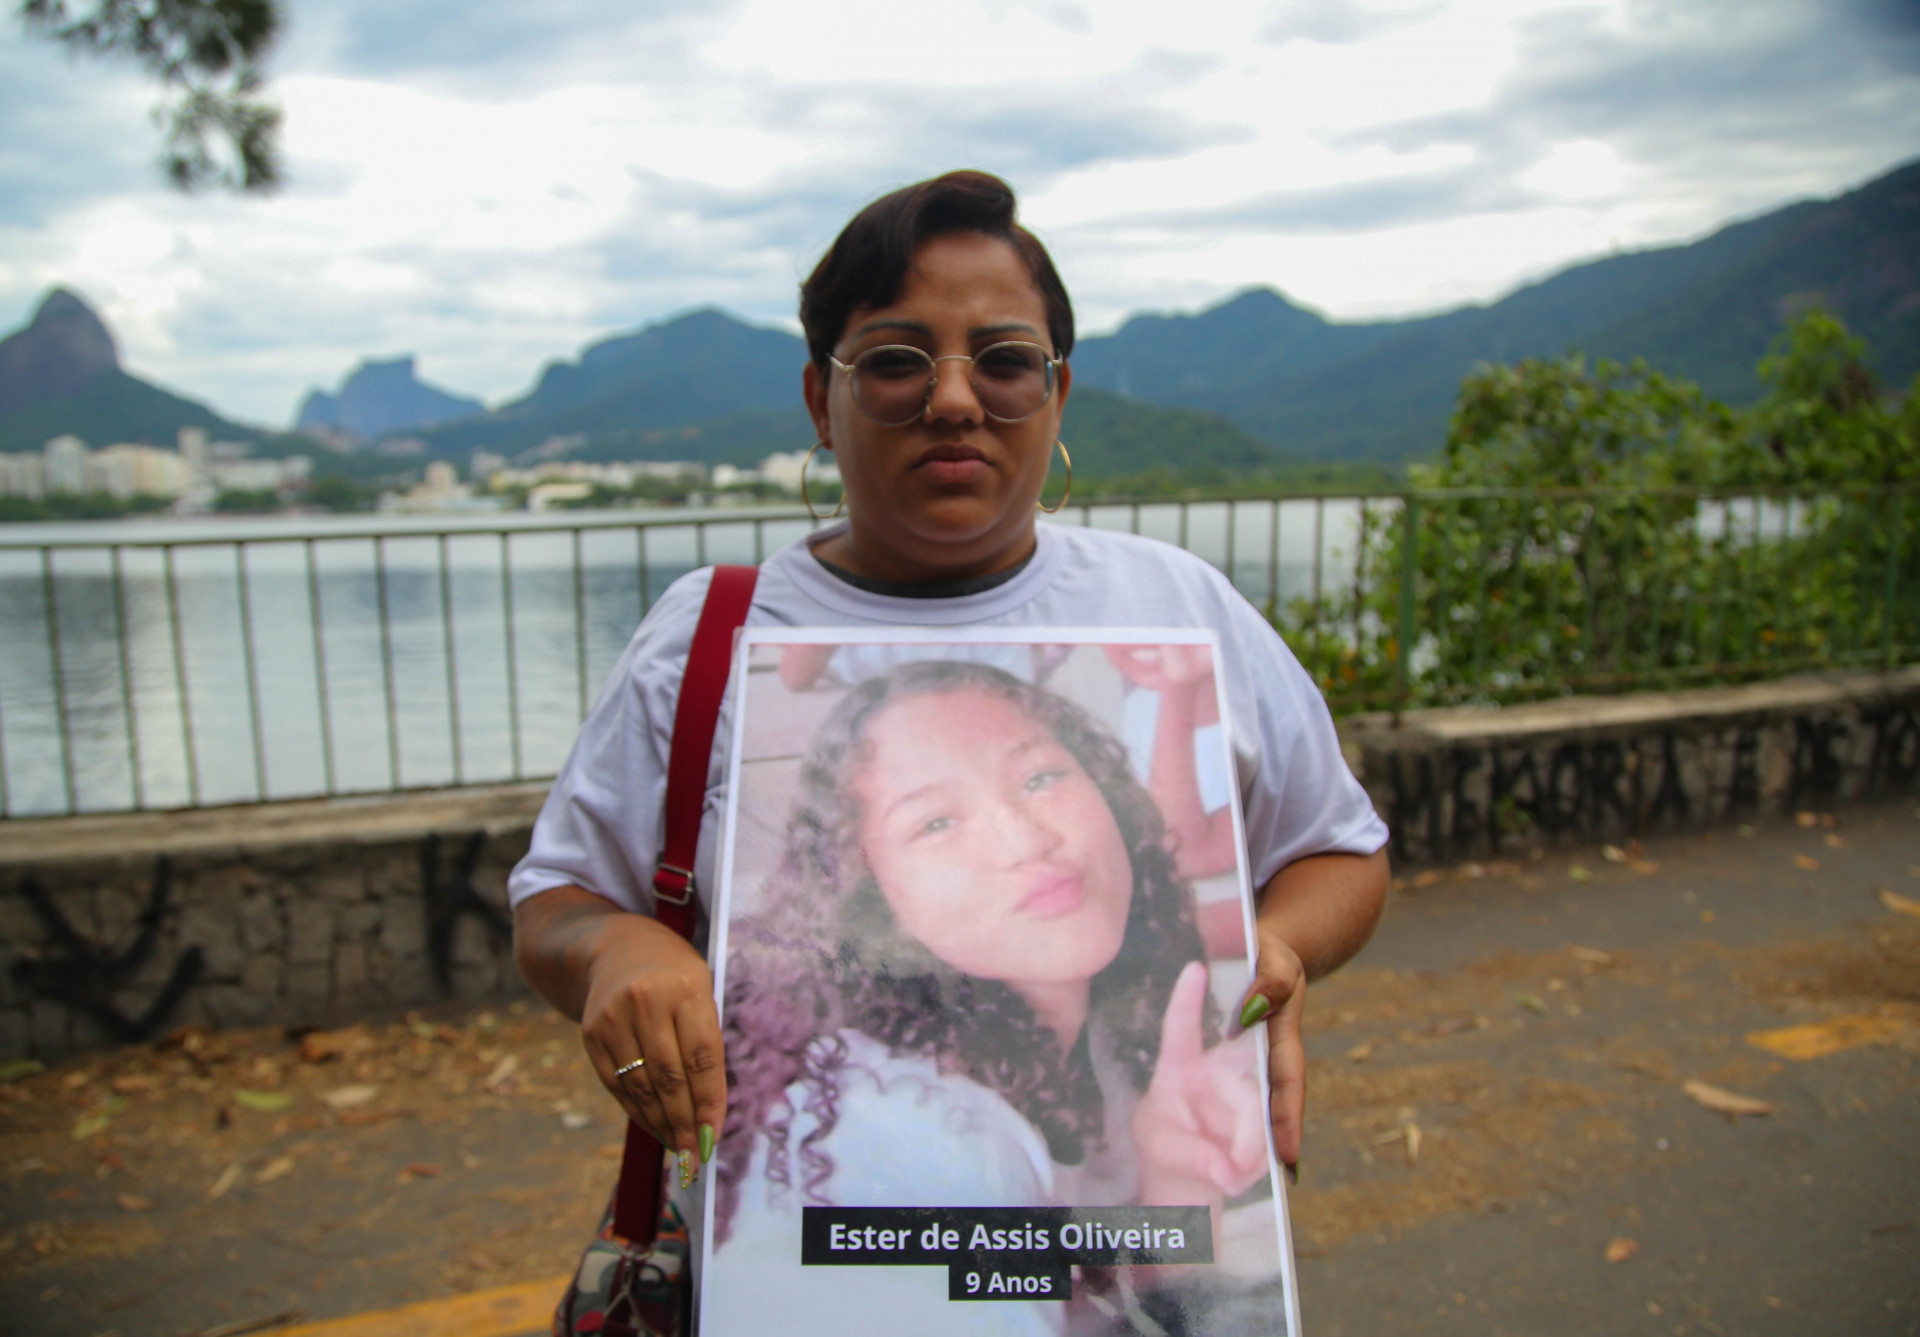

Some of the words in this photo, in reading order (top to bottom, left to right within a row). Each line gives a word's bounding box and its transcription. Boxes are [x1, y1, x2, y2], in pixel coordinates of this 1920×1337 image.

[830, 1224, 912, 1250] Ester
[920, 1222, 960, 1250] de
[968, 1222, 1050, 1250] Assis
[1060, 1222, 1185, 1250] Oliveira
[965, 1271, 981, 1293] 9
[987, 1271, 1052, 1293] Anos
